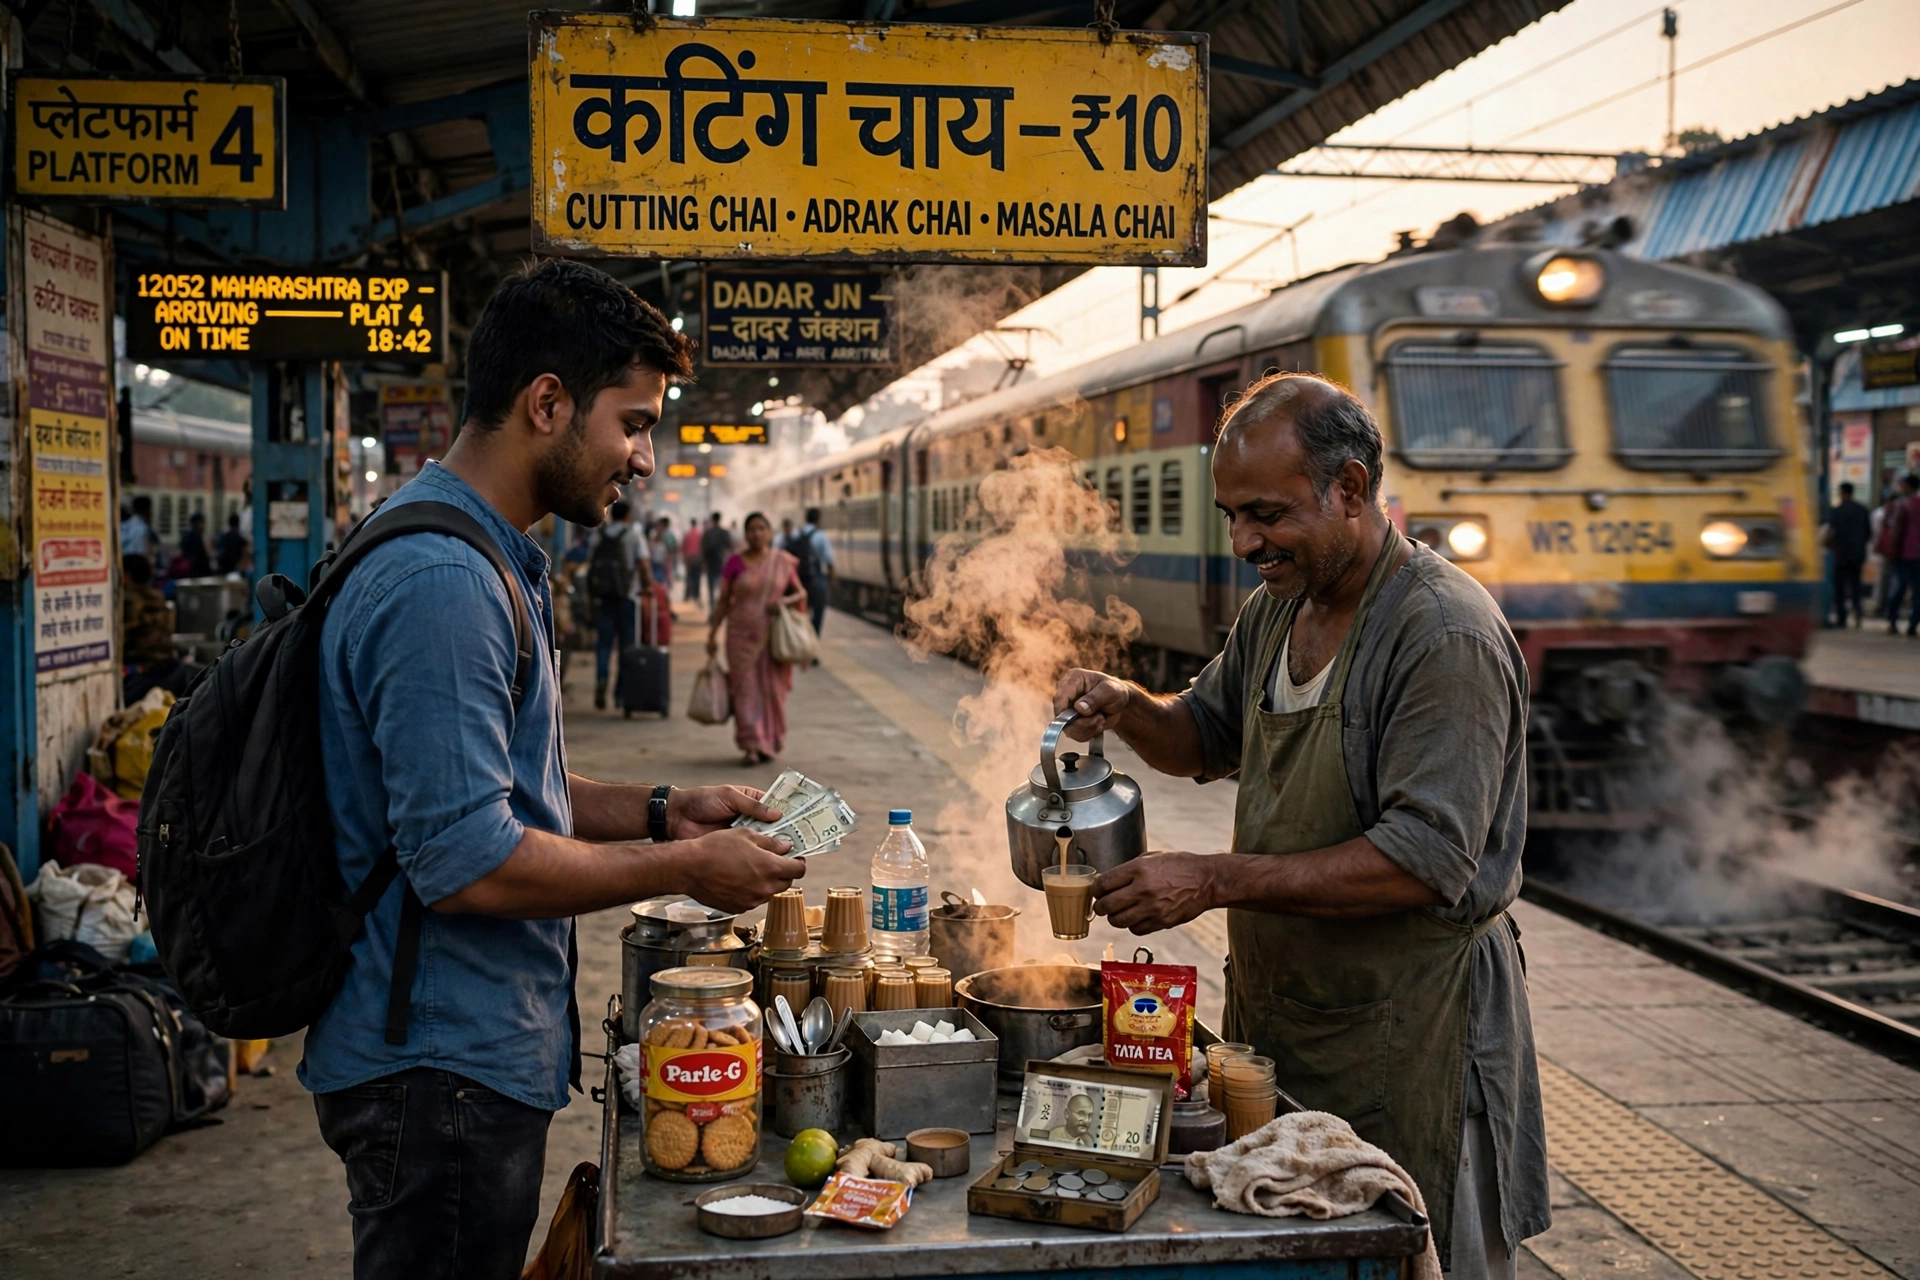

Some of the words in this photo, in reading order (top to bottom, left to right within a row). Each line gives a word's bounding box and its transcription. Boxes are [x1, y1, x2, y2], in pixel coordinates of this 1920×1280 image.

[28, 85, 198, 142] प्लेटफार्म
[570, 42, 828, 167] कटिंग
[845, 81, 1014, 172] चाय
[1071, 94, 1182, 173] ₹10
[210, 105, 262, 182] 4
[28, 150, 198, 185] PLATFORM
[566, 192, 699, 231] CUTTING
[710, 195, 777, 233] CHAI
[802, 197, 899, 235] ADRAK
[907, 199, 971, 236] CHAI
[997, 201, 1107, 238] MASALA
[1114, 204, 1175, 239] CHAI
[137, 274, 205, 298] 12052
[211, 275, 361, 300] MAHARASHTRA
[368, 278, 409, 301] EXP
[713, 280, 814, 309] DADAR
[824, 282, 862, 310] JN
[154, 300, 259, 325] ARRIVING
[350, 302, 403, 326] PLAT
[408, 303, 424, 327] 4
[731, 316, 792, 342] दादर
[799, 311, 881, 342] जंक्शन
[160, 326, 191, 350] ON
[197, 327, 250, 351] TIME
[367, 328, 432, 352] 18:42
[712, 345, 758, 360] DADAR
[1526, 521, 1577, 553] WR
[1587, 520, 1675, 554] 12054
[1113, 1044, 1143, 1059] TATA
[1148, 1046, 1173, 1060] TEA
[666, 1061, 741, 1083] Parle-G
[1125, 1131, 1140, 1145] 20
